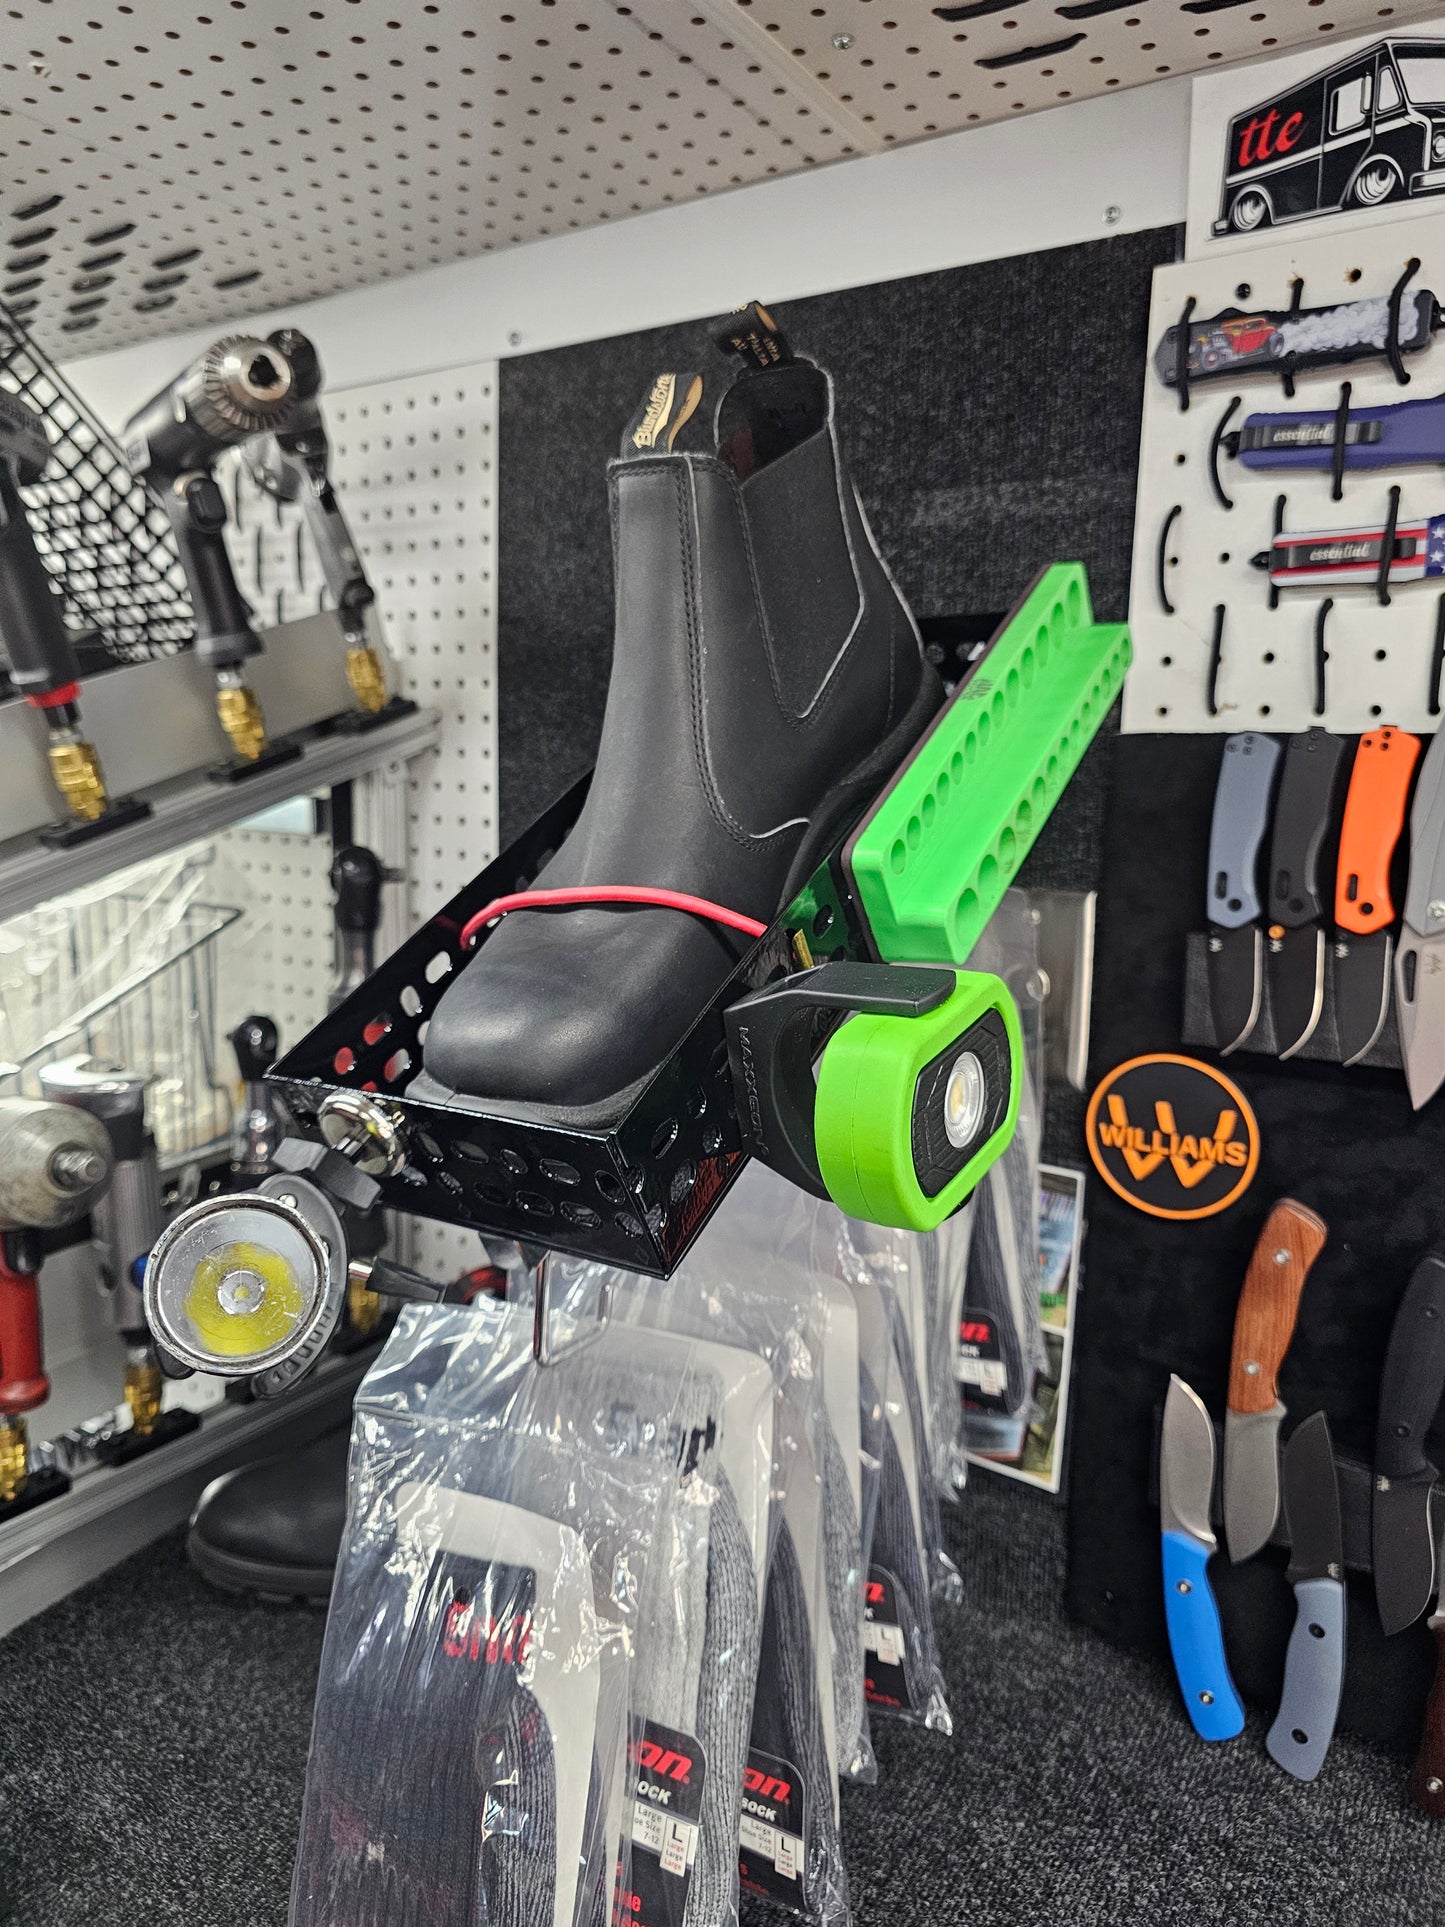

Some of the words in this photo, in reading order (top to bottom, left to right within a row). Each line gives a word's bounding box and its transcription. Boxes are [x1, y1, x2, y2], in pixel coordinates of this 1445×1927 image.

[1273, 423, 1335, 442] essential
[1309, 541, 1370, 561] essential
[739, 1026, 764, 1147] MAXXEON
[1098, 1122, 1248, 1167] WILLIAMS
[638, 1805, 662, 1823] Large
[645, 1820, 661, 1834] Size
[672, 1822, 683, 1843] L
[643, 1832, 660, 1845] 7-12
[781, 1835, 792, 1854] L
[664, 1858, 682, 1871] Large
[665, 1849, 683, 1861] Large
